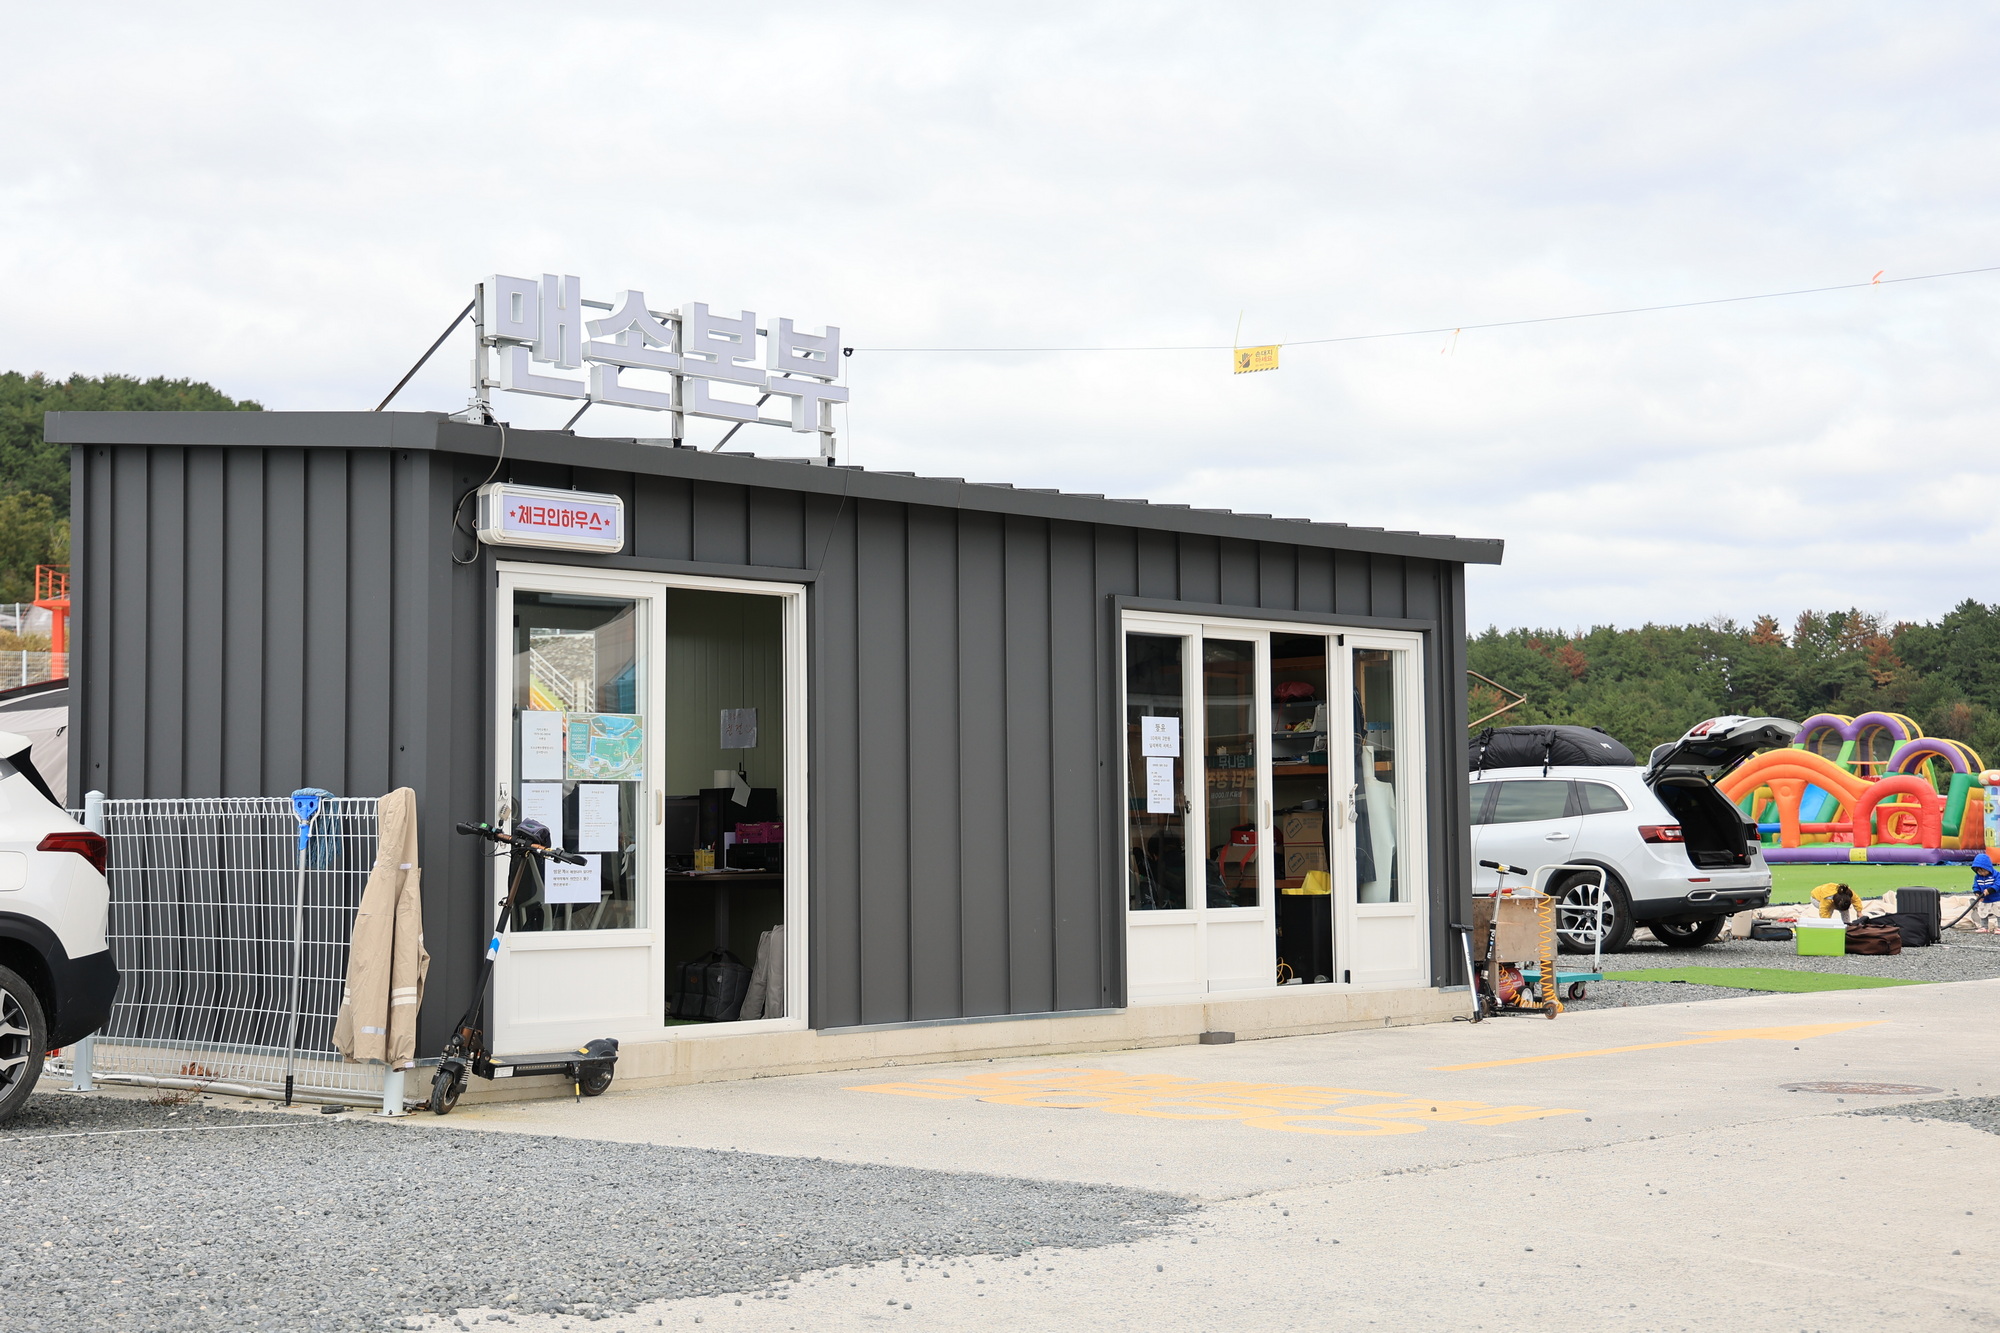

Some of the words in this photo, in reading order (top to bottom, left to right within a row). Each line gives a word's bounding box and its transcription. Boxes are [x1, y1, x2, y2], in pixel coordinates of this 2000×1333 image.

[484, 273, 850, 433] 맨손본부
[518, 504, 602, 531] 체크인하우스
[842, 1067, 1588, 1136] 일방통행
